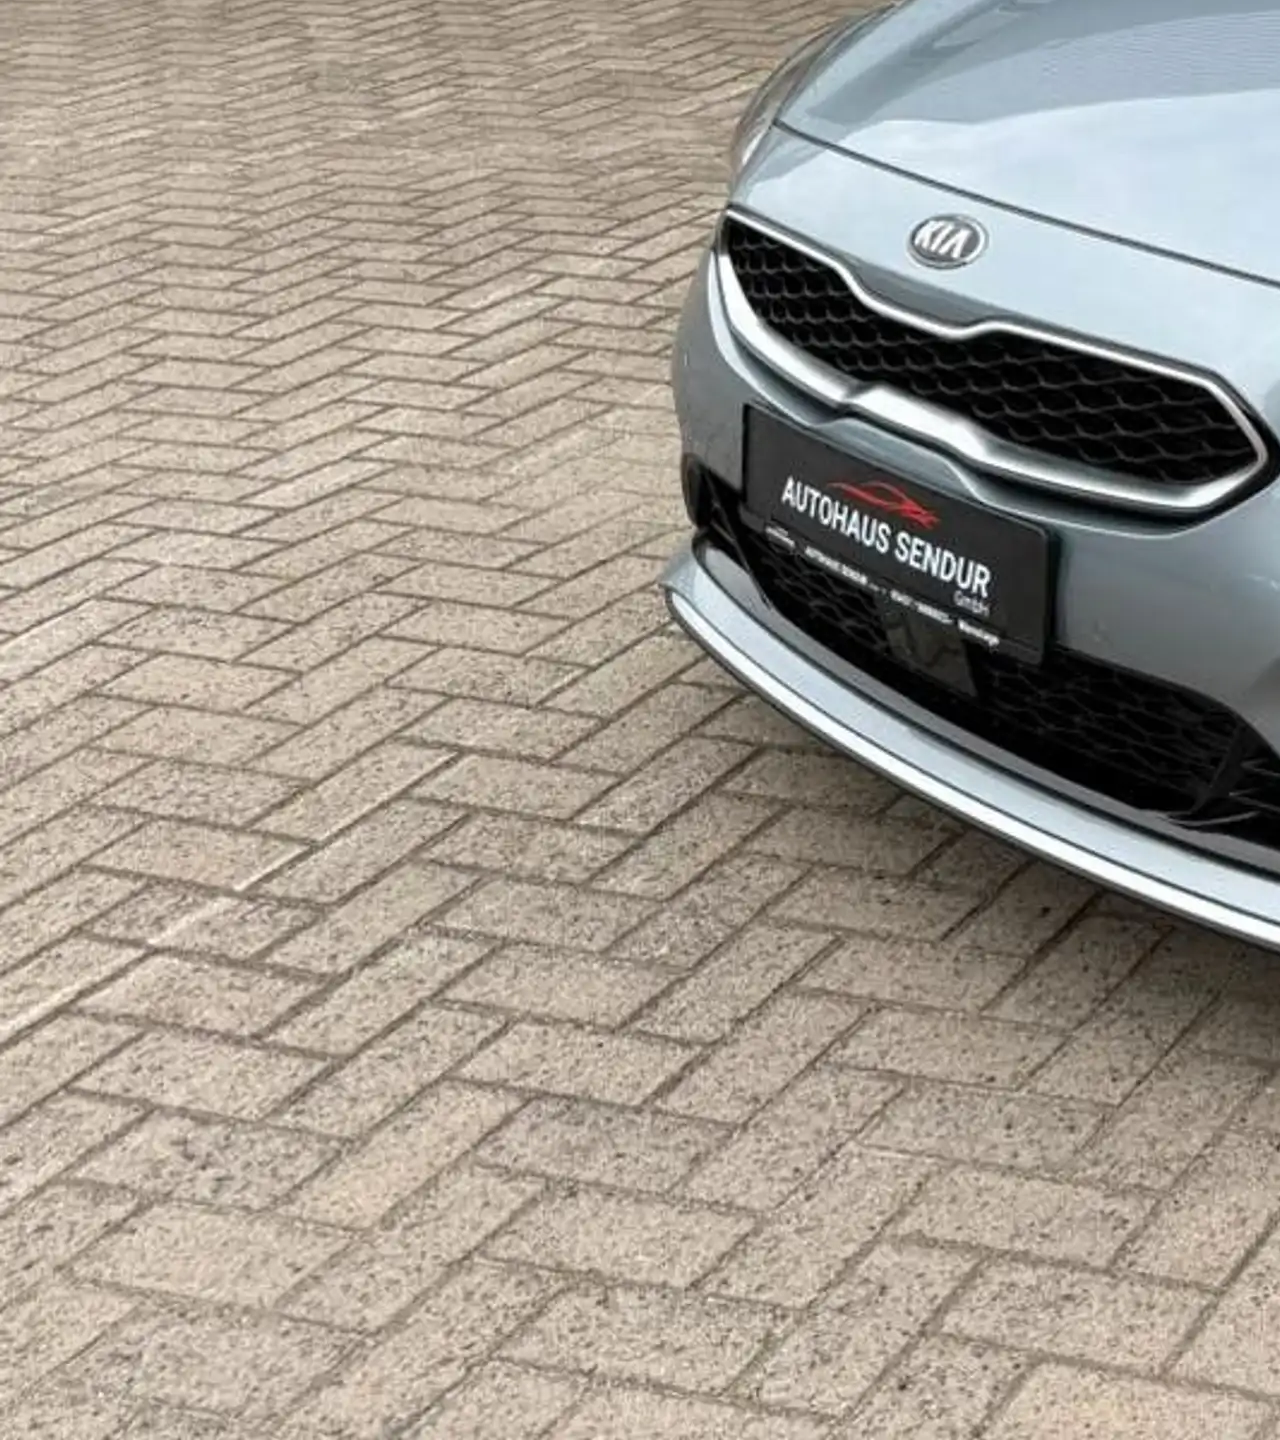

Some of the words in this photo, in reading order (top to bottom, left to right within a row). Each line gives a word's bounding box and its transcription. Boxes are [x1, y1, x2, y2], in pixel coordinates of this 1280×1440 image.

[914, 220, 971, 258] KIA
[781, 475, 890, 554] AUTOHAUS
[893, 531, 992, 598] SENDUR
[953, 589, 992, 617] GmbH
